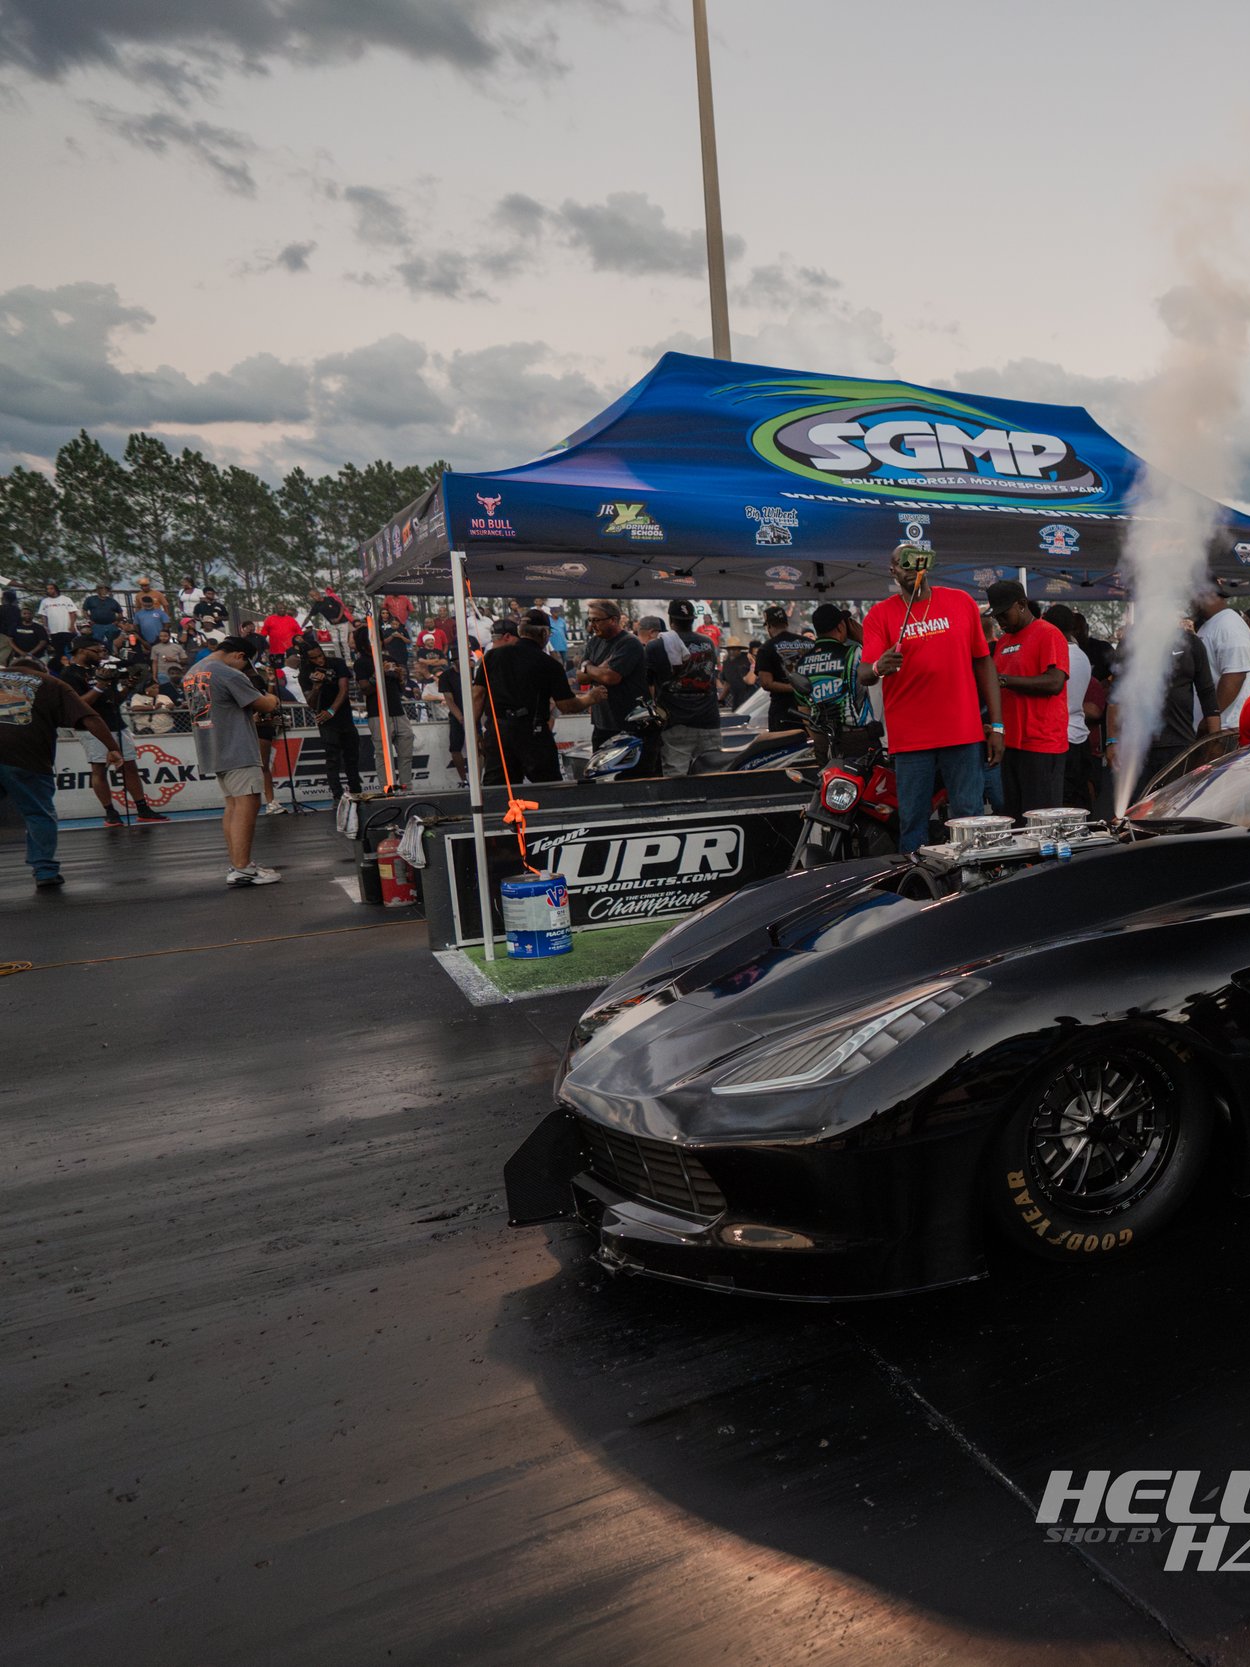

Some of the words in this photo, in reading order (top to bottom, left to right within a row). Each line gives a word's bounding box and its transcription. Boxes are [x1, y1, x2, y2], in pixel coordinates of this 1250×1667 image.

[808, 420, 1067, 477] SGMP
[841, 477, 894, 486] SOUTH
[897, 476, 967, 486] GEORGIA
[970, 477, 1069, 492] MOTORSPORTS
[1070, 486, 1105, 494] PARK
[597, 504, 614, 517] JR
[745, 506, 761, 522] Big
[469, 529, 505, 537] INSURANCE,
[471, 518, 486, 529] NO
[488, 519, 513, 530] BULL
[798, 660, 845, 675] OFFICIAL
[804, 652, 832, 664] TRACK
[812, 678, 844, 699] GMP
[110, 764, 218, 787] BRAK
[527, 827, 591, 856] Team
[555, 829, 738, 886] UPR
[582, 872, 720, 895] PRODUCTS.COM
[546, 885, 565, 908] VP
[587, 889, 711, 921] Champions
[640, 892, 664, 900] CHOICE
